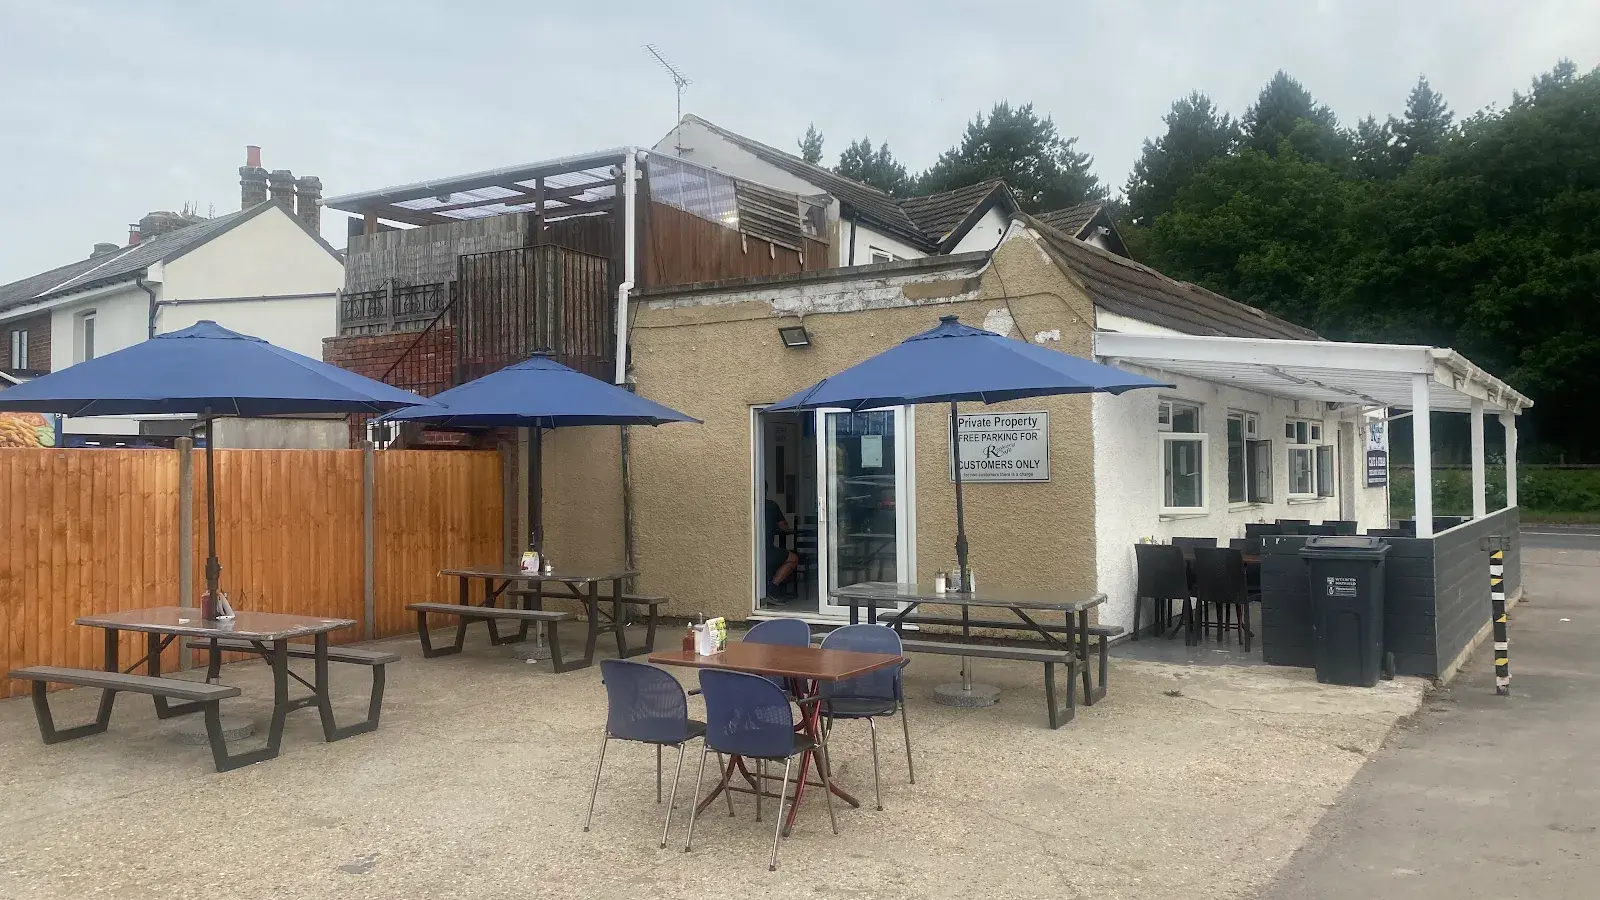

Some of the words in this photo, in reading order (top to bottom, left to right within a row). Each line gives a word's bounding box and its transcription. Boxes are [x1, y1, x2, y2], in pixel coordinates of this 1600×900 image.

[958, 418, 991, 428] Private
[994, 416, 1038, 428] Property
[958, 433, 980, 442] FREE
[981, 432, 1018, 442] PARKING
[1020, 432, 1038, 441] FOR
[959, 460, 1013, 470] CUSTOMERS
[1015, 459, 1040, 469] ONLY
